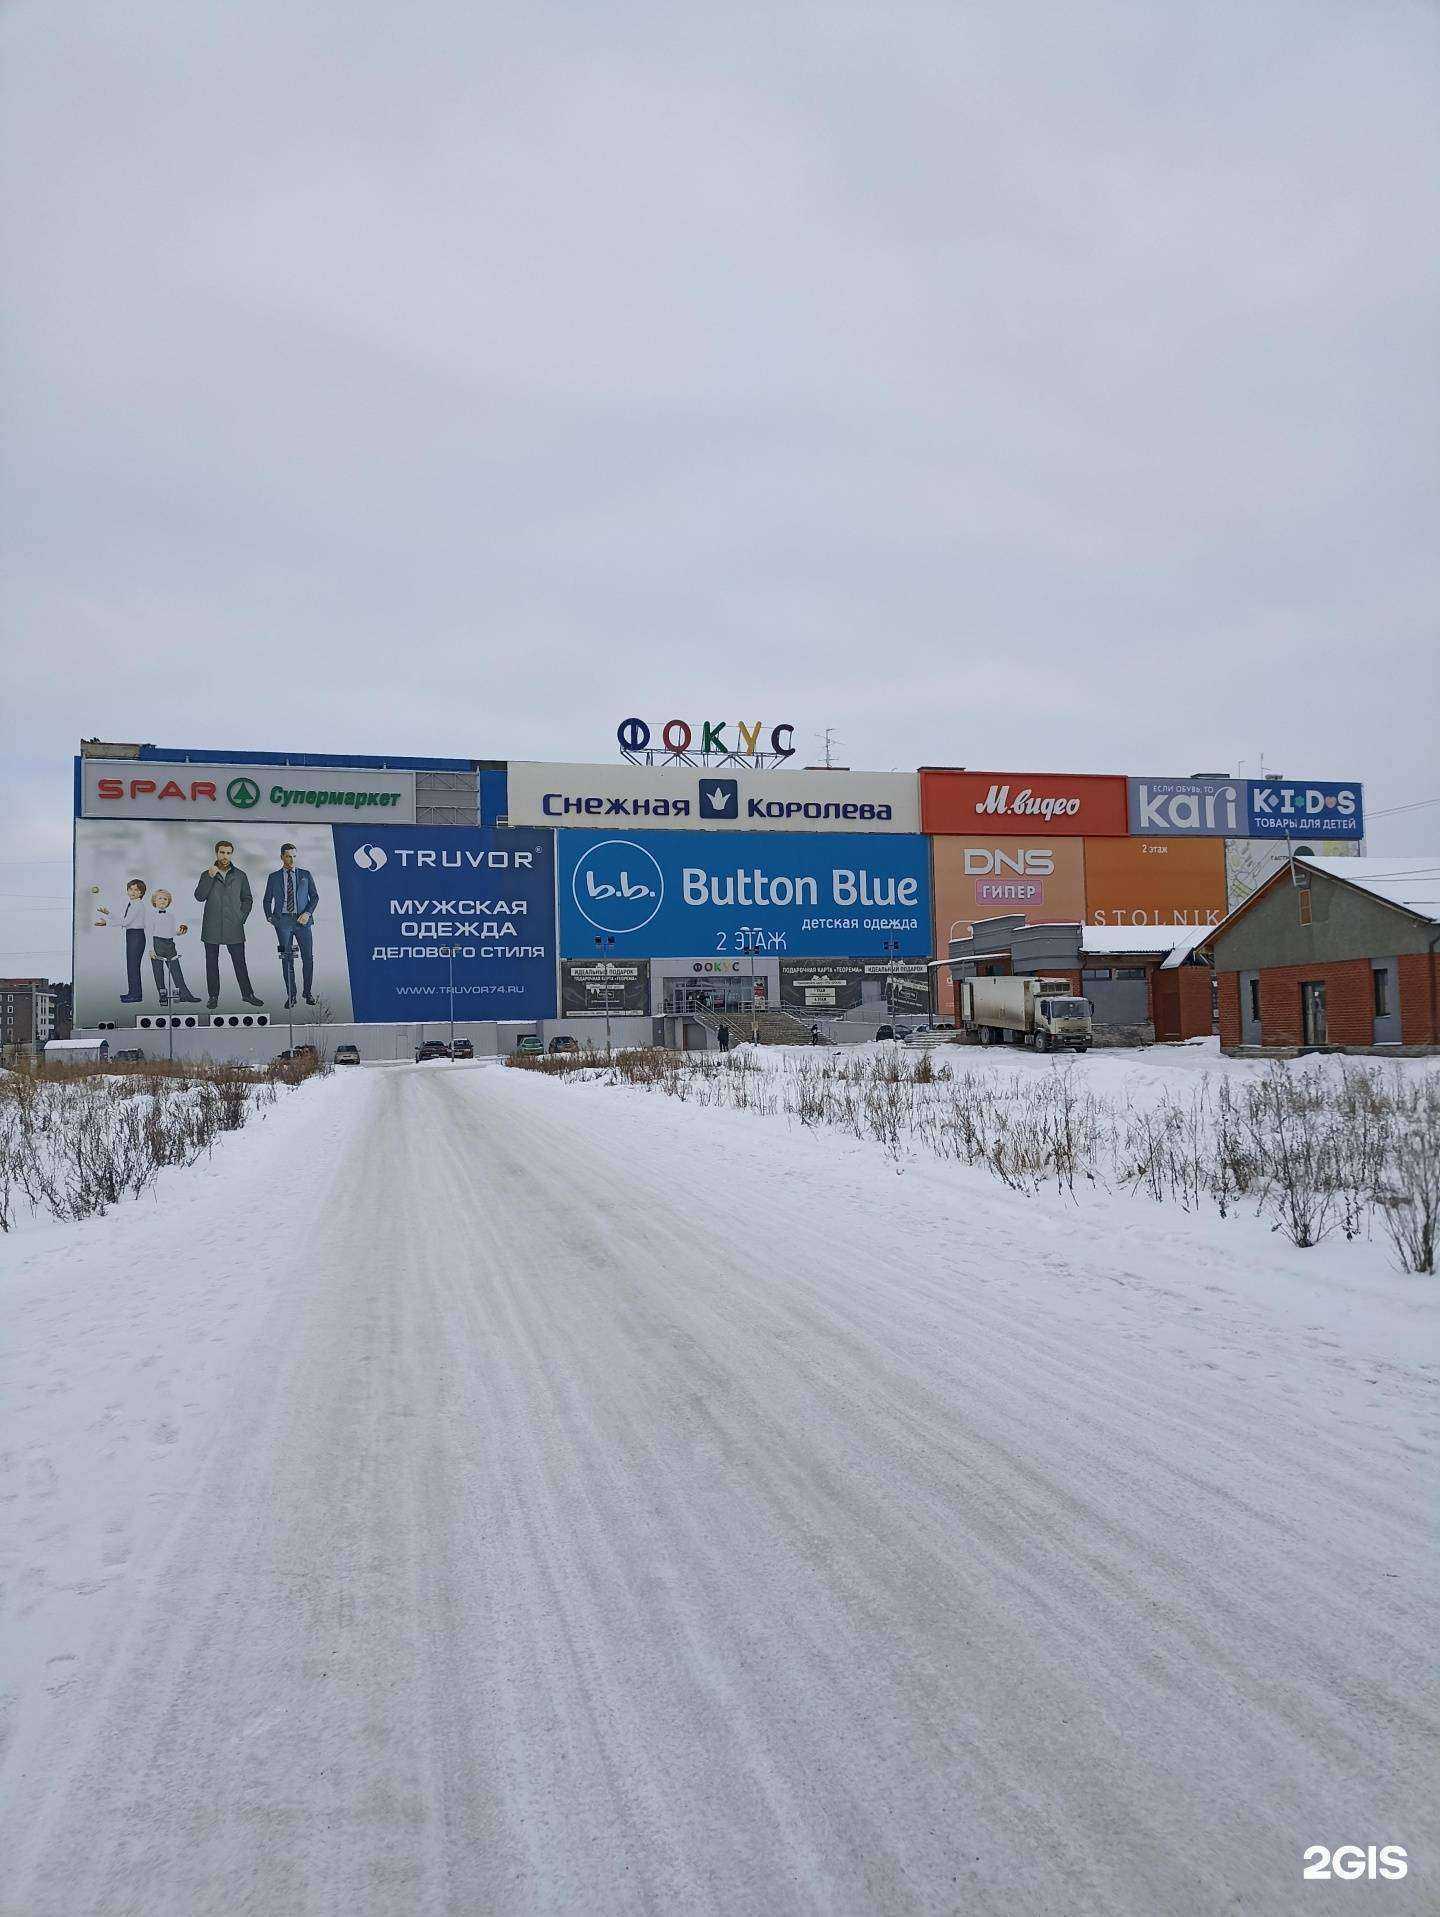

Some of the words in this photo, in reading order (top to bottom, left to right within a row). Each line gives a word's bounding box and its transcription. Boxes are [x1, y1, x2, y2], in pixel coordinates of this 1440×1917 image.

[617, 717, 796, 756] ФОКУС
[98, 779, 217, 801] SPAR
[269, 785, 401, 809] Супермаркет
[542, 793, 690, 817] Снежная
[748, 798, 892, 821] Королева
[976, 785, 1081, 821] М.видео
[1139, 785, 1237, 829] kari
[1254, 818, 1297, 828] ТОВАРЫ
[1300, 818, 1320, 829] ДЛЯ
[1323, 818, 1356, 829] ДЕТЕЙ
[1142, 844, 1147, 852] 2
[1149, 845, 1168, 854] этаж
[963, 848, 1055, 876] DNS
[682, 867, 818, 906] Button
[832, 868, 919, 907] Blue
[981, 884, 1037, 901] ГИПЕР
[390, 899, 528, 916] МУЖСКАЯ
[801, 917, 859, 931] детская
[863, 917, 918, 931] одежда
[1094, 909, 1222, 926] STOLNIK
[401, 920, 518, 939] ОДЕЖДА
[716, 931, 727, 950] 2
[734, 931, 788, 951] ЭТАЖ
[372, 946, 476, 961] ДЕЛОВОГО
[480, 945, 545, 959] СТИЛЯ
[693, 962, 740, 972] ФОКУС
[396, 984, 525, 996] WWW.TRUVOR74.RU
